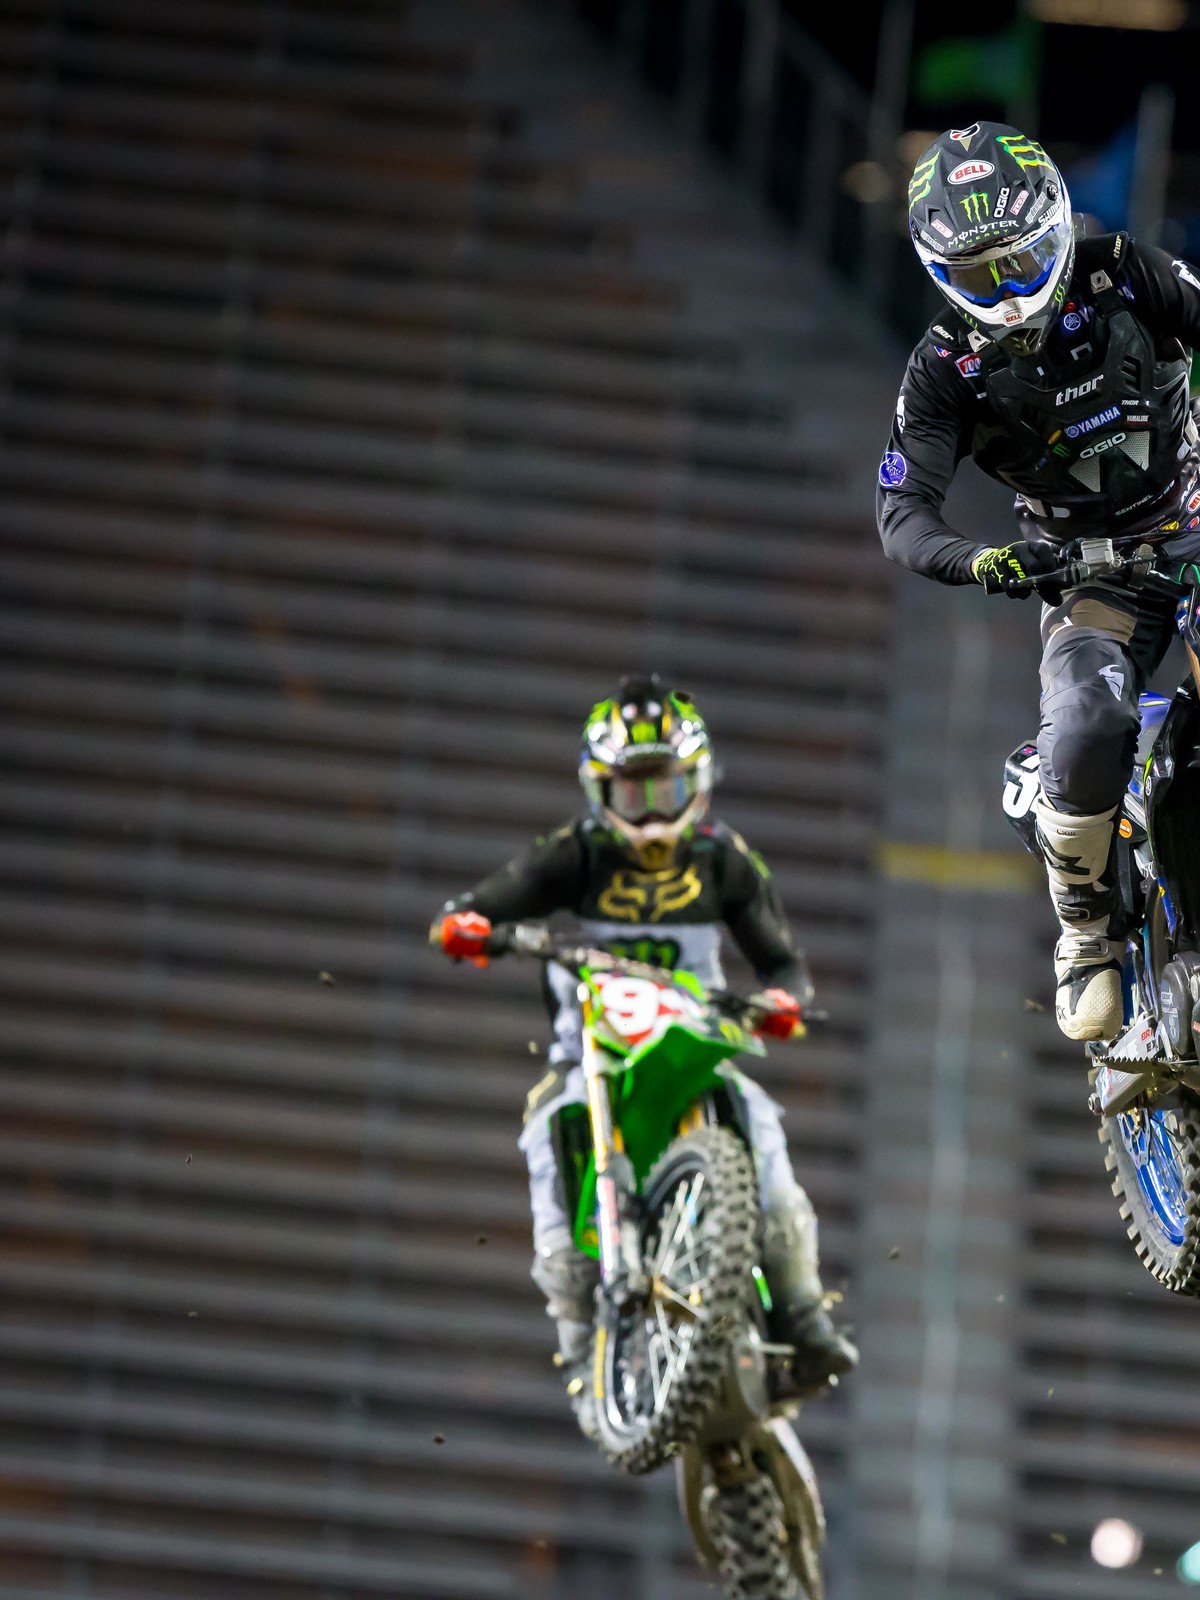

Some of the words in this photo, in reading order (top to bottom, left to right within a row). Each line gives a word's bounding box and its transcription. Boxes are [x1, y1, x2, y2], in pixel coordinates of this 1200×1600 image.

[954, 164, 988, 180] BELL
[993, 187, 1010, 218] OGIO
[947, 219, 1020, 248] MONSTER
[958, 229, 1009, 250] ENERGY
[1005, 313, 1022, 323] BELL
[1055, 374, 1104, 406] thor
[1078, 405, 1121, 433] YAMAHA
[1080, 432, 1127, 459] OGIO
[1114, 493, 1154, 517] SENTINEL
